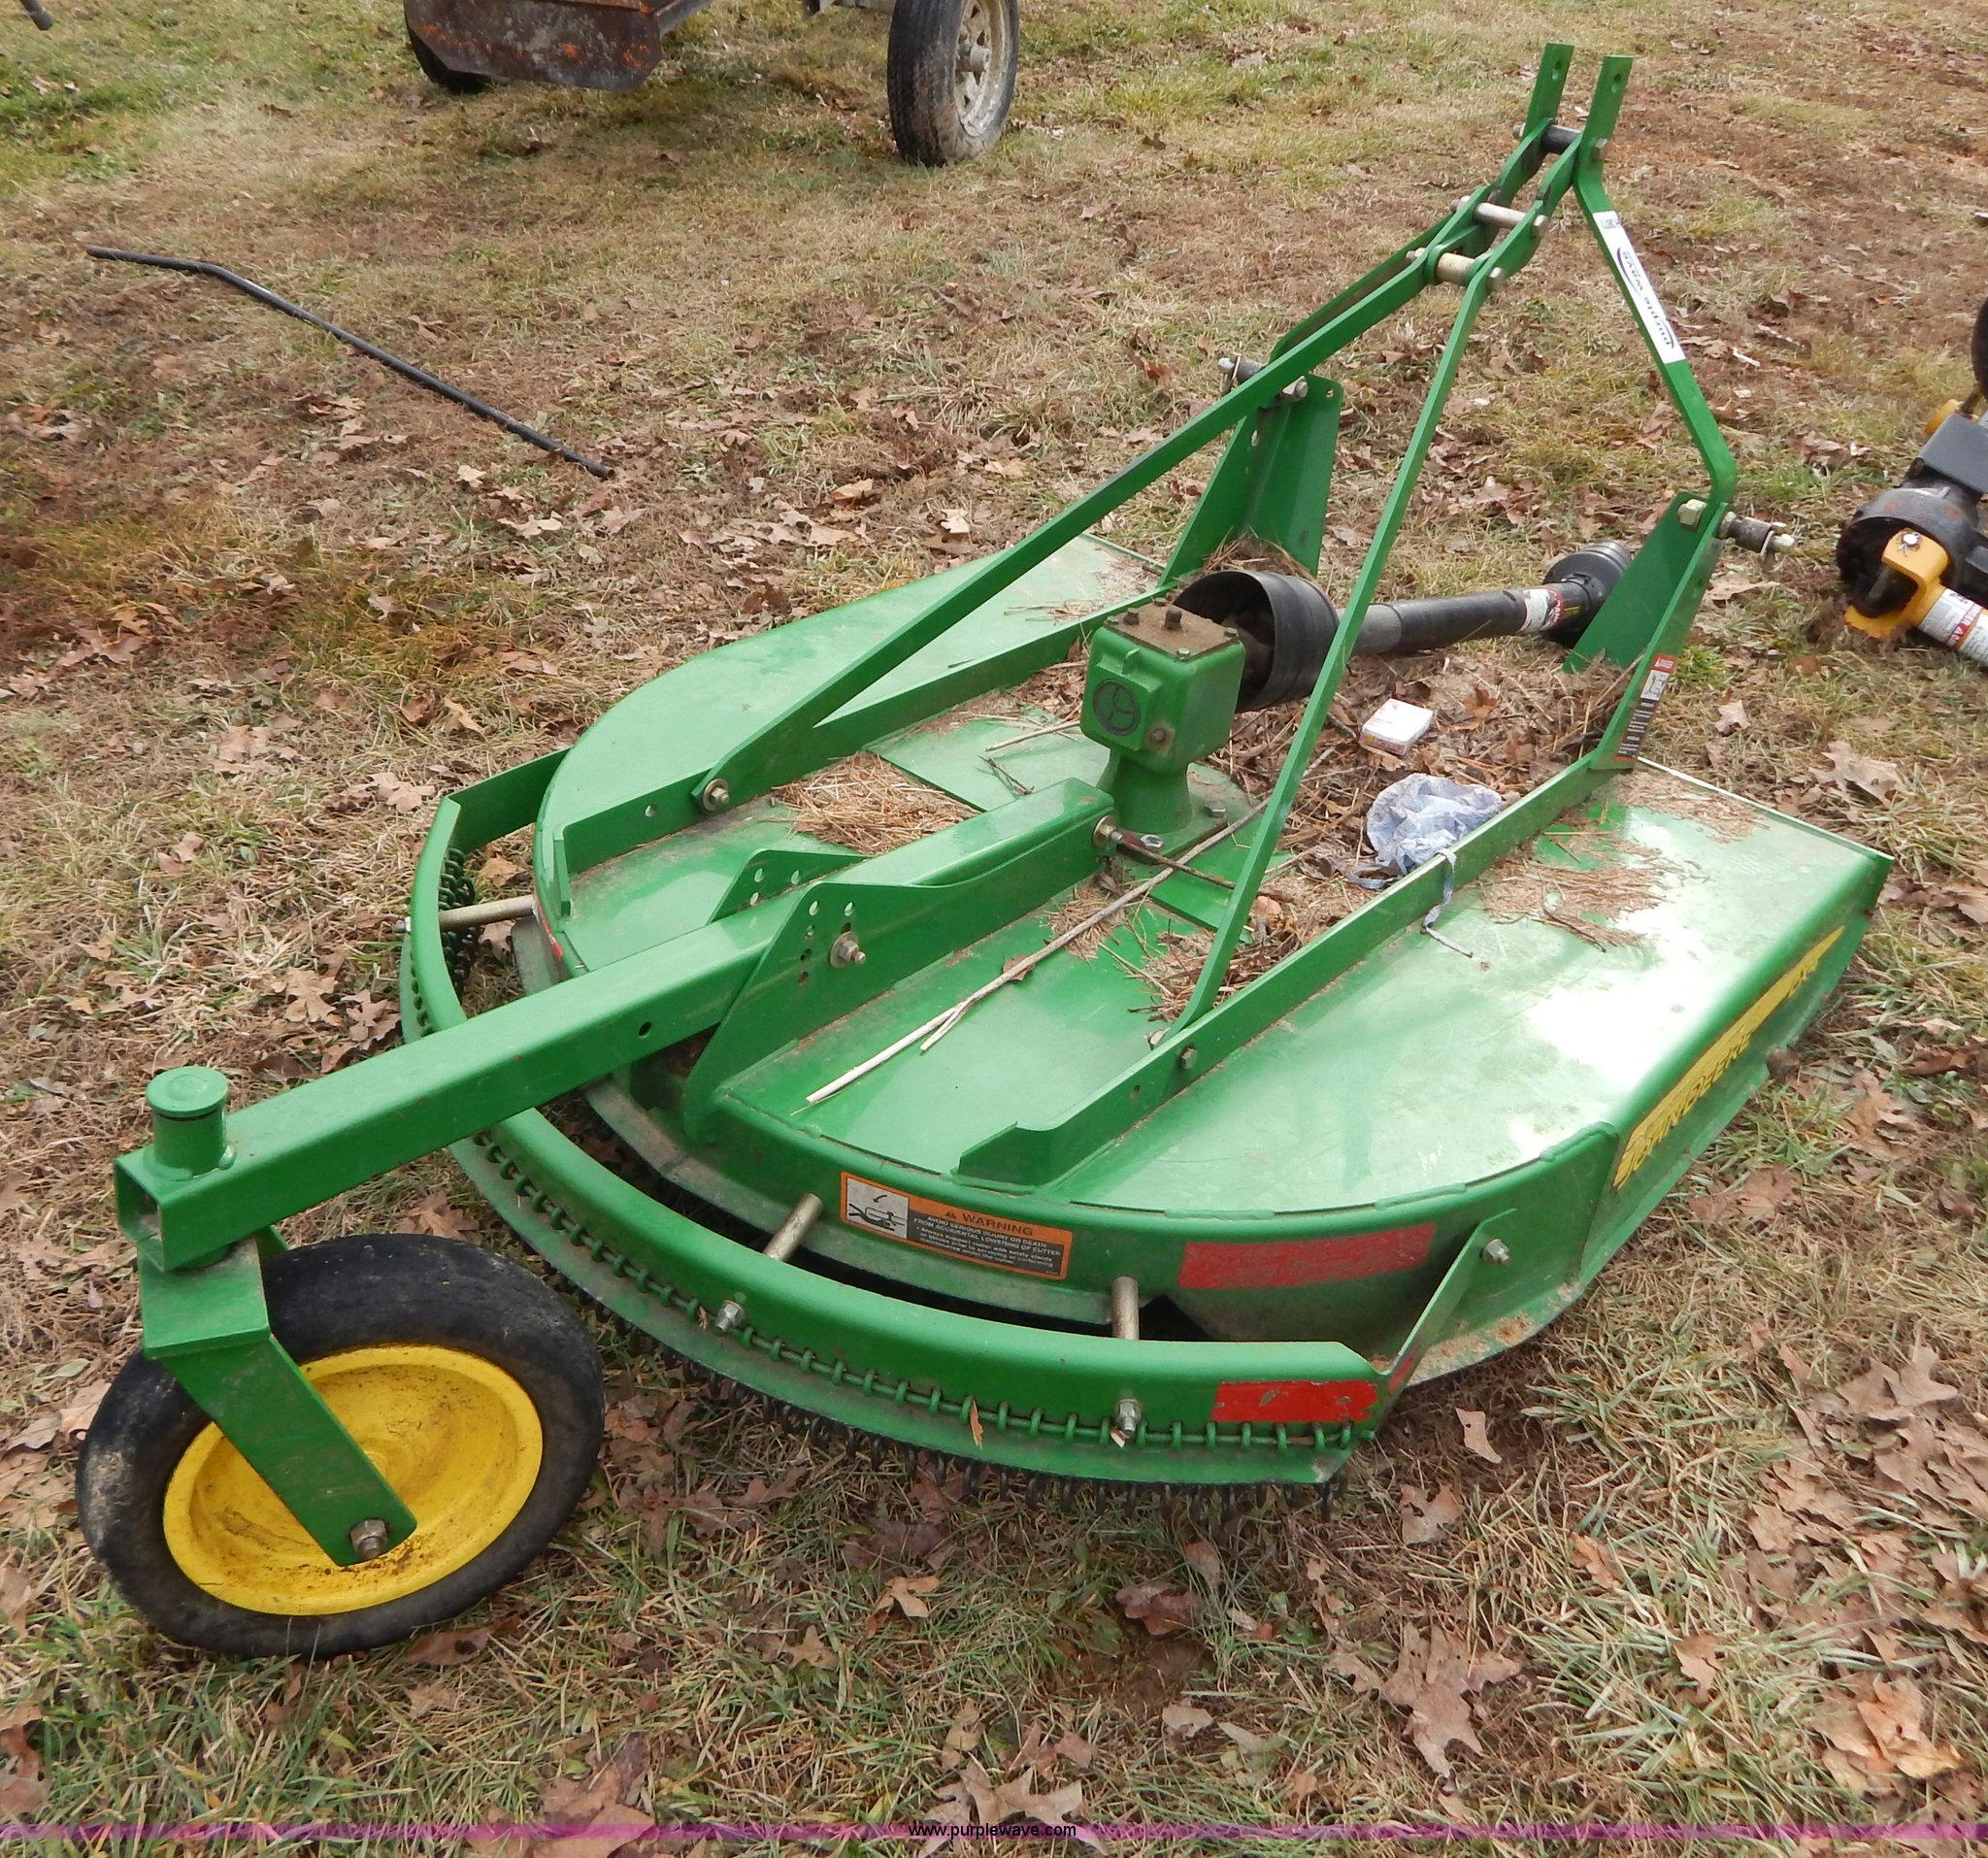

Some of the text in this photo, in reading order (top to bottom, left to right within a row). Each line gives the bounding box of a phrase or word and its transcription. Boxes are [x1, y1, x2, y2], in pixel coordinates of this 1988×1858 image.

[913, 1217, 934, 1227] FROM
[935, 1224, 979, 1240] ACCIDENTAL
[980, 1235, 1019, 1248] LOWERING
[1032, 1246, 1061, 1256] CUTTER
[920, 1227, 944, 1238] Always
[927, 1216, 949, 1226] AVOID
[949, 1222, 981, 1235] SERIOUS
[982, 1230, 1009, 1241] INJURY
[1022, 1239, 1046, 1248] DEATH
[962, 1212, 1033, 1236] WARNING
